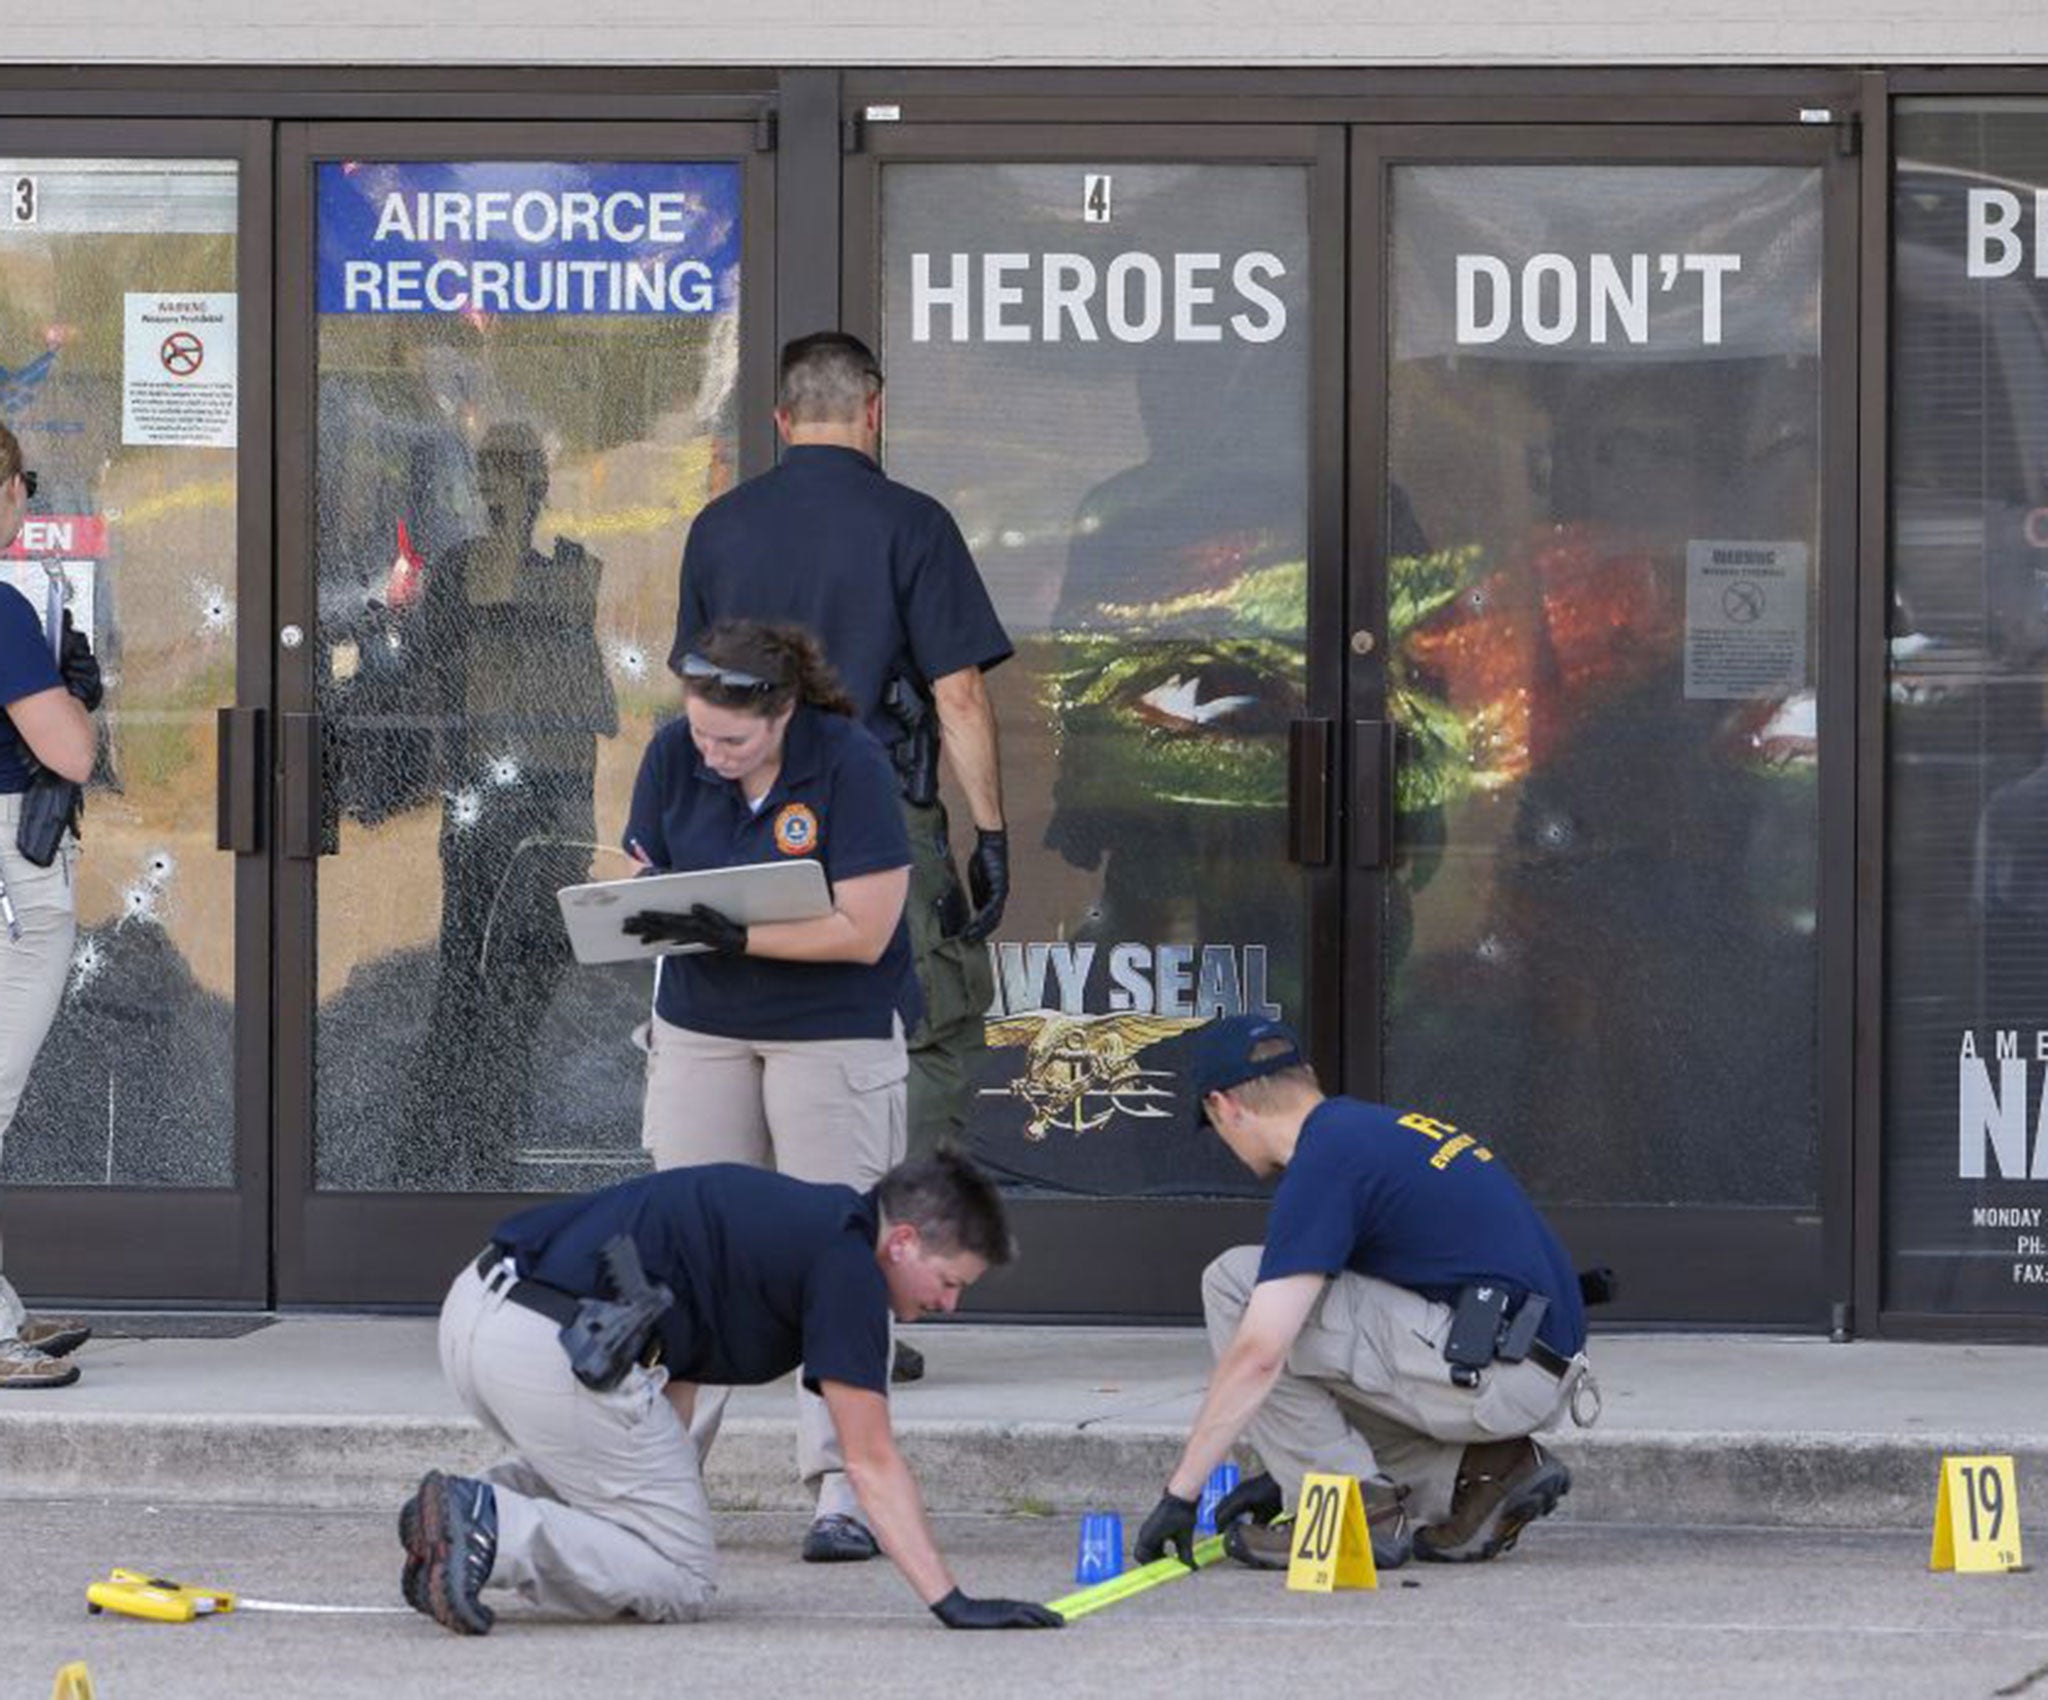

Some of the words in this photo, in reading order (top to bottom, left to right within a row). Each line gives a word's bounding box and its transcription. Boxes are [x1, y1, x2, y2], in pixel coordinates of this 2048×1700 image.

[16, 178, 34, 220] 3
[373, 191, 687, 243] AIRFORCE
[1087, 177, 1108, 220] 4
[1967, 188, 2048, 278] B
[344, 259, 714, 313] RECRUITING
[911, 251, 1288, 344] HEROES
[1455, 253, 1742, 345] DON'T
[1109, 941, 1282, 1022] SEAL
[1973, 1207, 2042, 1227] MONDAY
[1297, 1484, 1340, 1562] 20
[1960, 1465, 2004, 1541] 19
